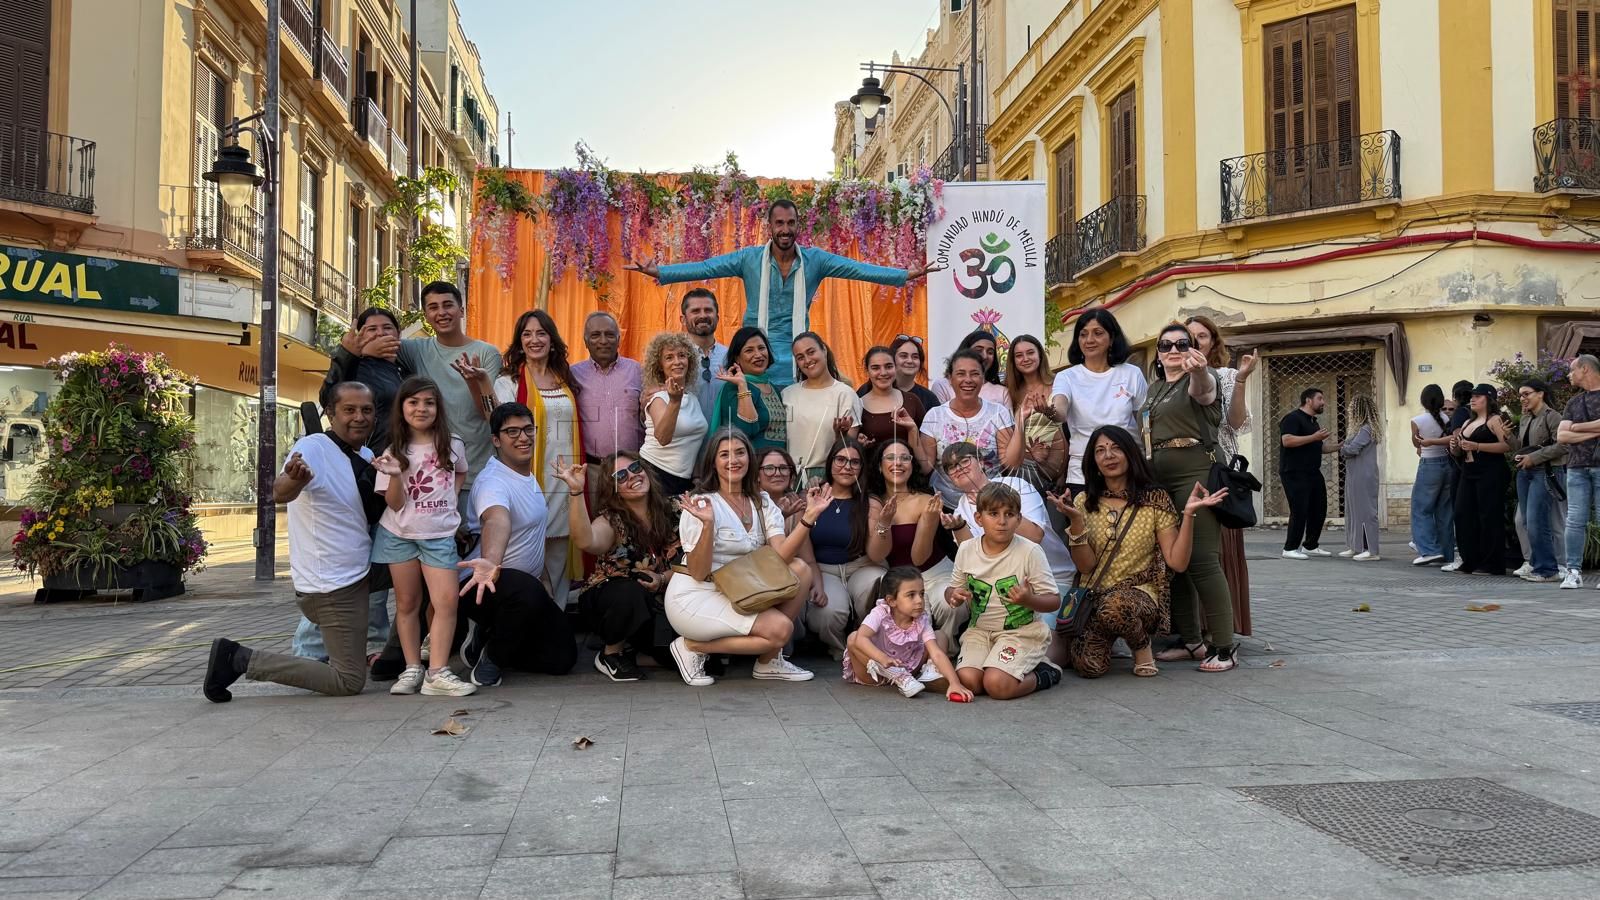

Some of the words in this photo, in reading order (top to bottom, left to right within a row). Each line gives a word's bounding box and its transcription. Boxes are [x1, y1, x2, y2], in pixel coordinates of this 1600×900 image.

[937, 216, 969, 270] COMUNIDAD
[972, 209, 1005, 224] HINDÚ
[1006, 216, 1021, 231] DE
[1017, 228, 1038, 268] MELILLA
[13, 313, 36, 323] RUAL
[238, 360, 260, 386] RUAL
[415, 500, 448, 508] FLEURS
